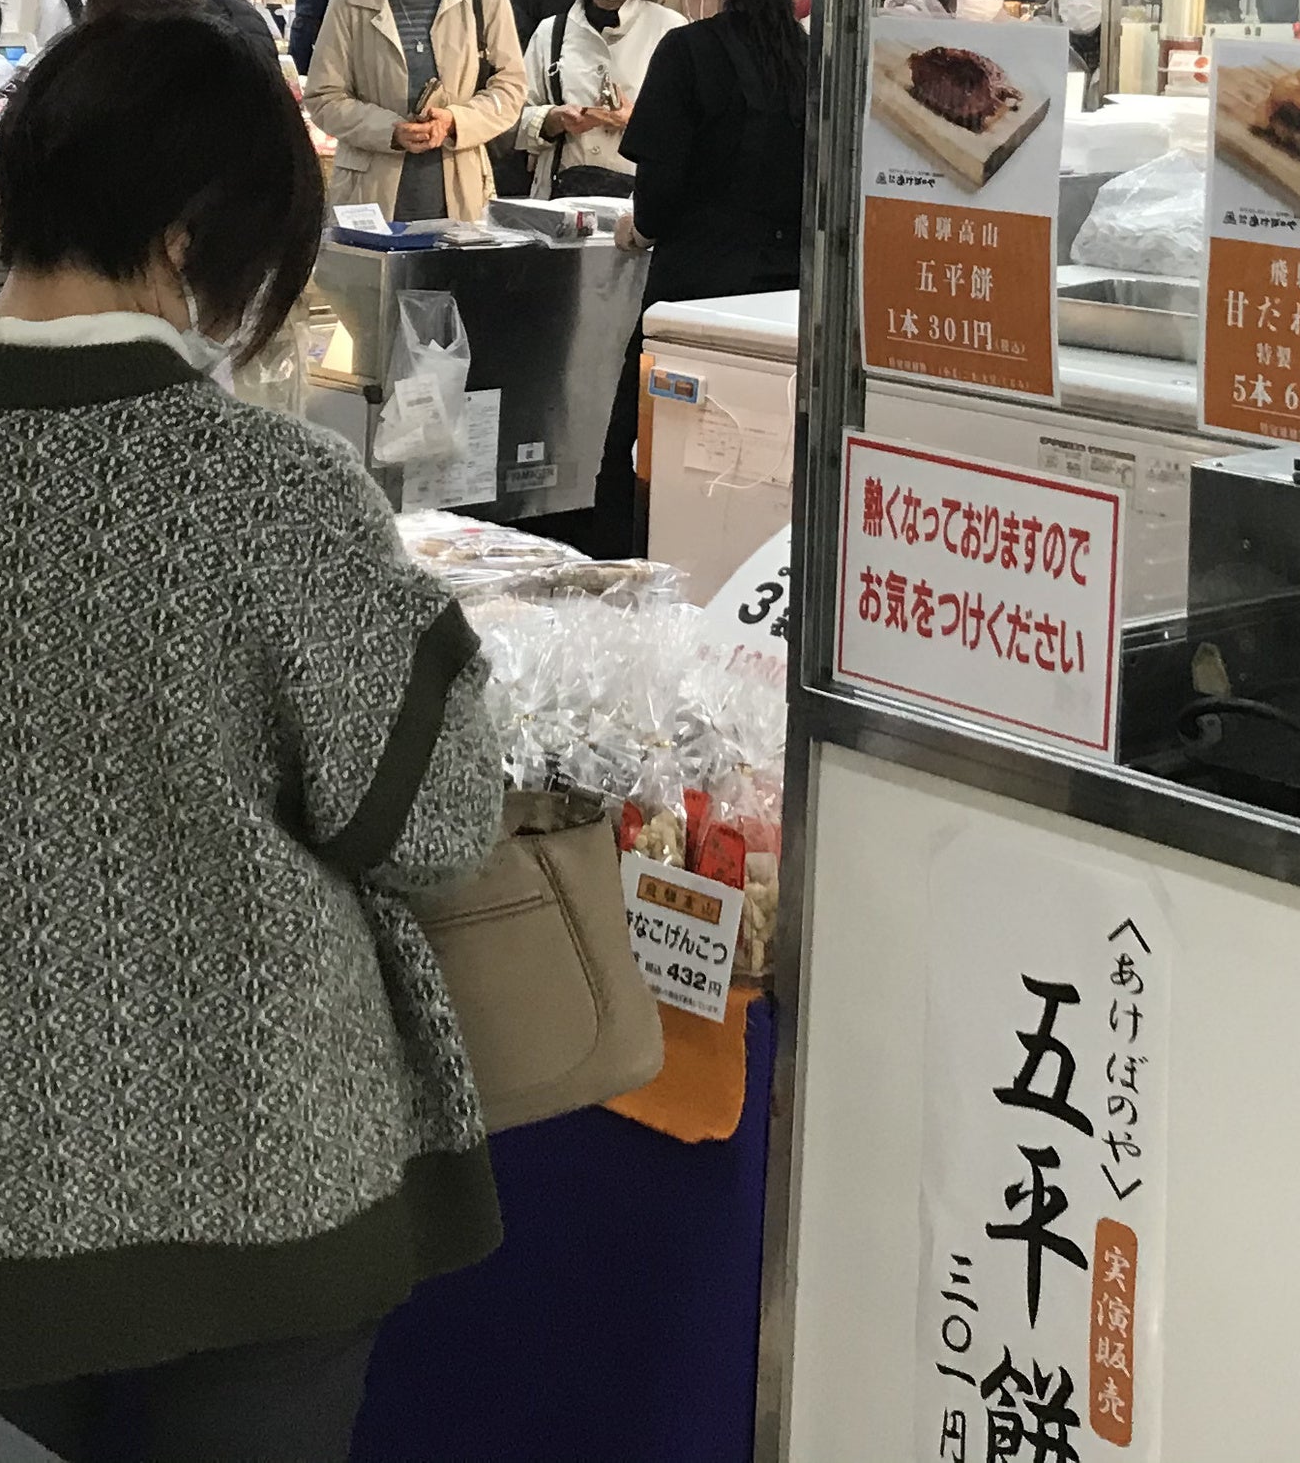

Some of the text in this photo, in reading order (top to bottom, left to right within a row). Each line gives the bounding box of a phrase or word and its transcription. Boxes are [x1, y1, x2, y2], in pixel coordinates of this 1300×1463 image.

[914, 213, 999, 250] 飛騨高山
[916, 258, 995, 303] 五平餅
[887, 307, 919, 339] 1本
[929, 314, 992, 351] 301円
[1256, 343, 1291, 370] 特製
[1233, 374, 1273, 408] 5本
[861, 476, 1092, 587] 熱くなっておりますので
[858, 564, 1085, 675] お気をつけください
[980, 973, 1095, 1463] 五平餅
[1095, 1245, 1133, 1423] 実演販売
